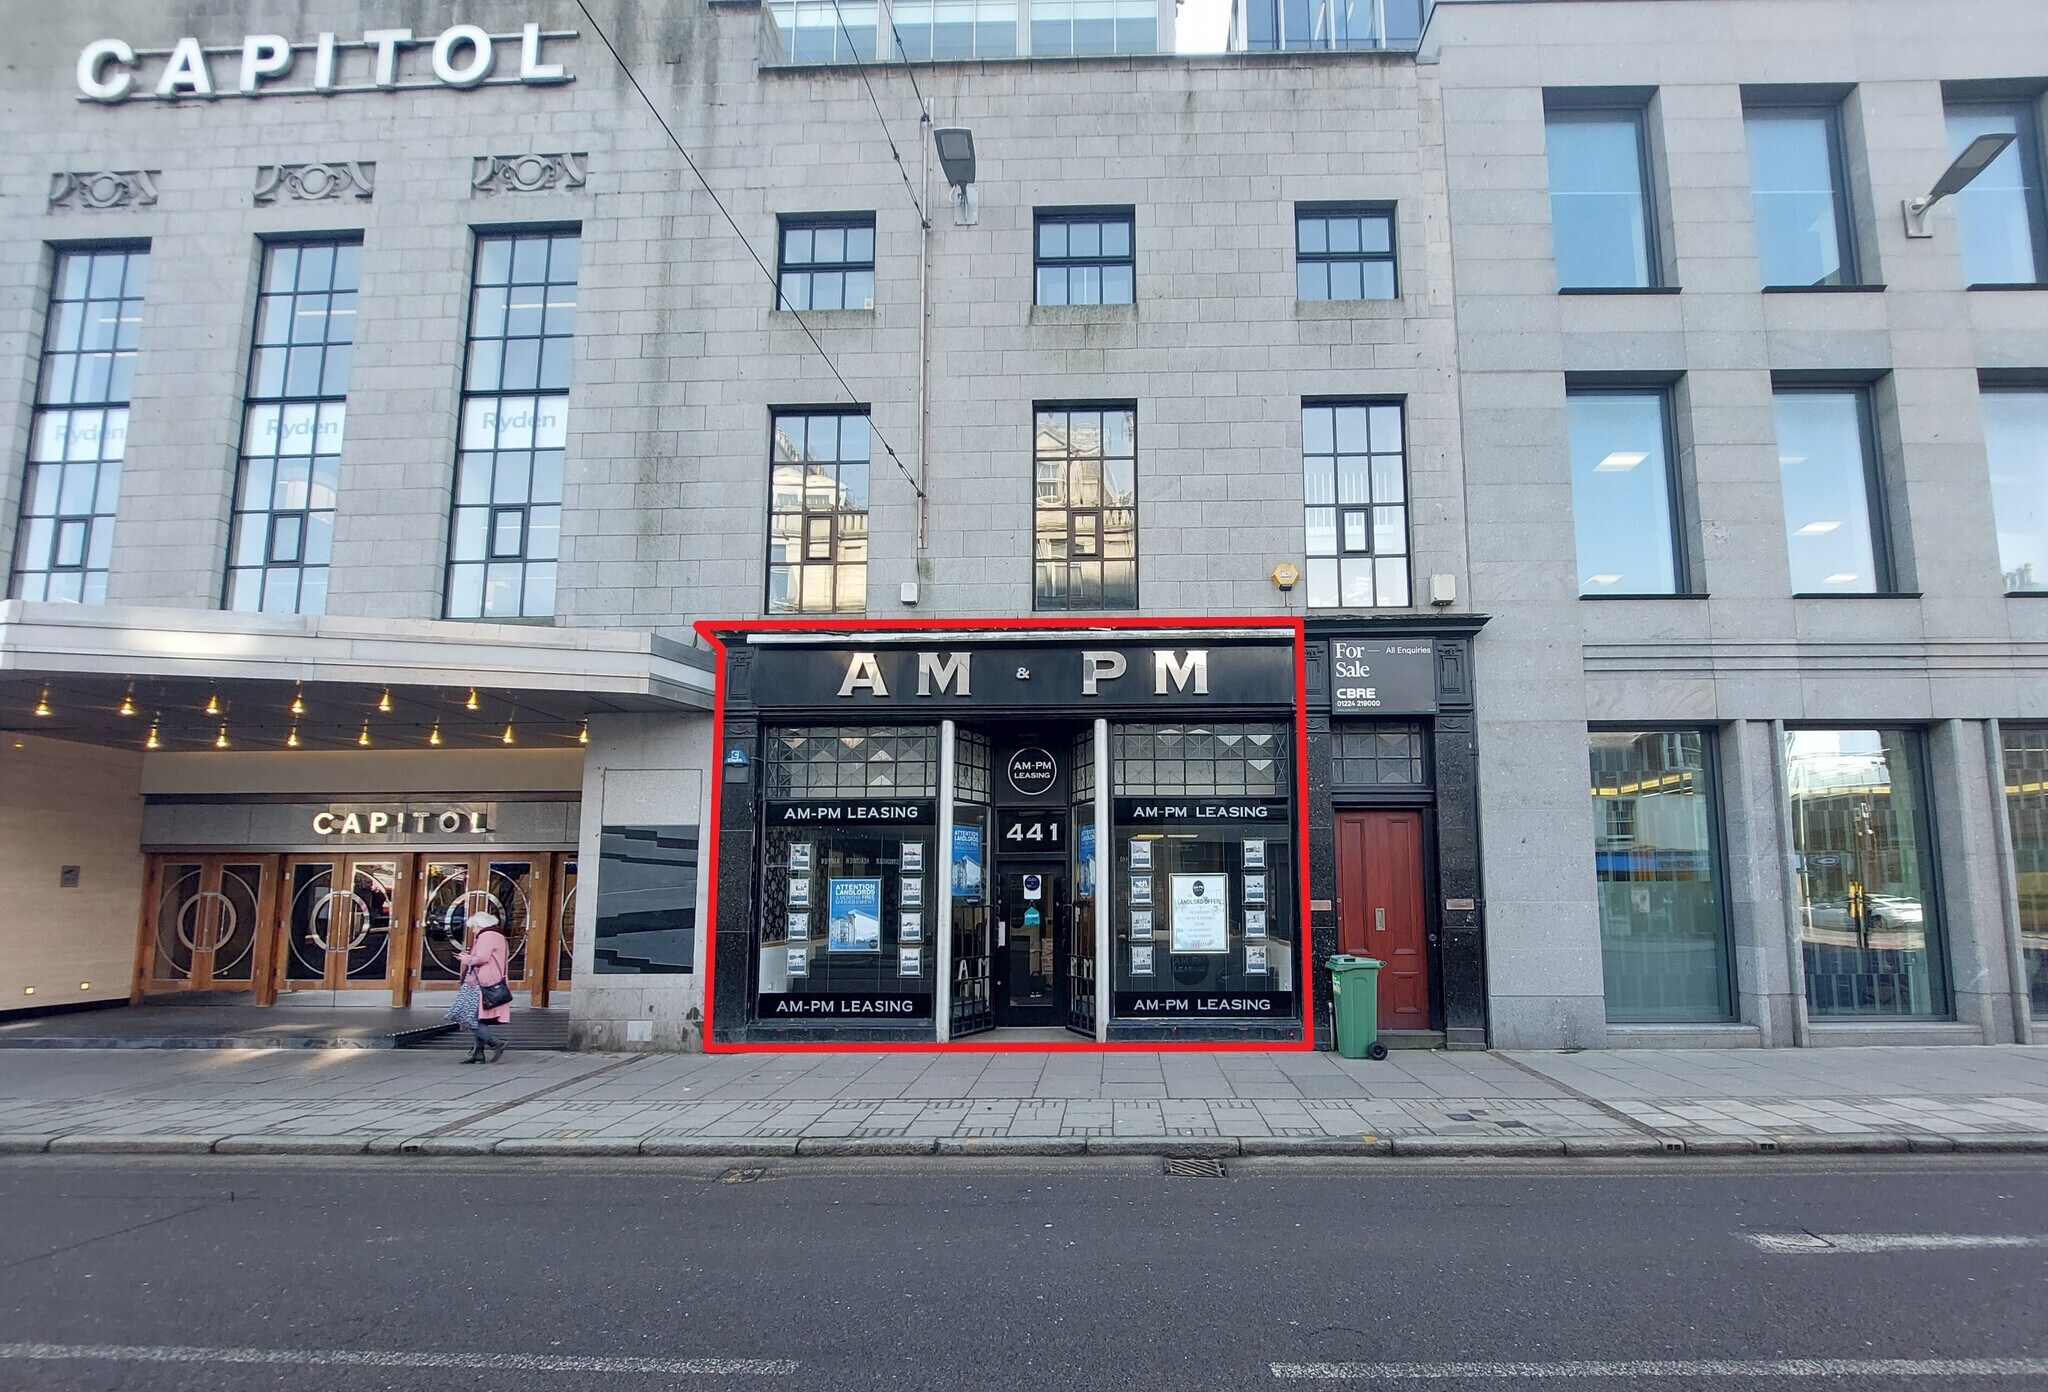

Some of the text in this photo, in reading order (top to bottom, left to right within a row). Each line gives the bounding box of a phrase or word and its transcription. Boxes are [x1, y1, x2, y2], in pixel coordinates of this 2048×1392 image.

[76, 22, 568, 99] CAPITOL
[266, 417, 338, 439] Ryden
[482, 411, 556, 433] Ryden
[1334, 642, 1365, 659] For
[1385, 646, 1431, 655] All Enquiries
[1016, 667, 1030, 681] &
[1335, 660, 1370, 678] Sale
[1336, 687, 1376, 699] CBRE
[1013, 761, 1052, 770] AM-PM
[784, 806, 918, 819] AM-PM LEASING
[1133, 806, 1268, 818] AM-PM LEASING
[312, 811, 487, 835] CAPITOL
[1006, 822, 1058, 841] 441
[776, 1000, 914, 1012] AM-PM LEASING
[1133, 999, 1271, 1011] AM-PM LEASING
